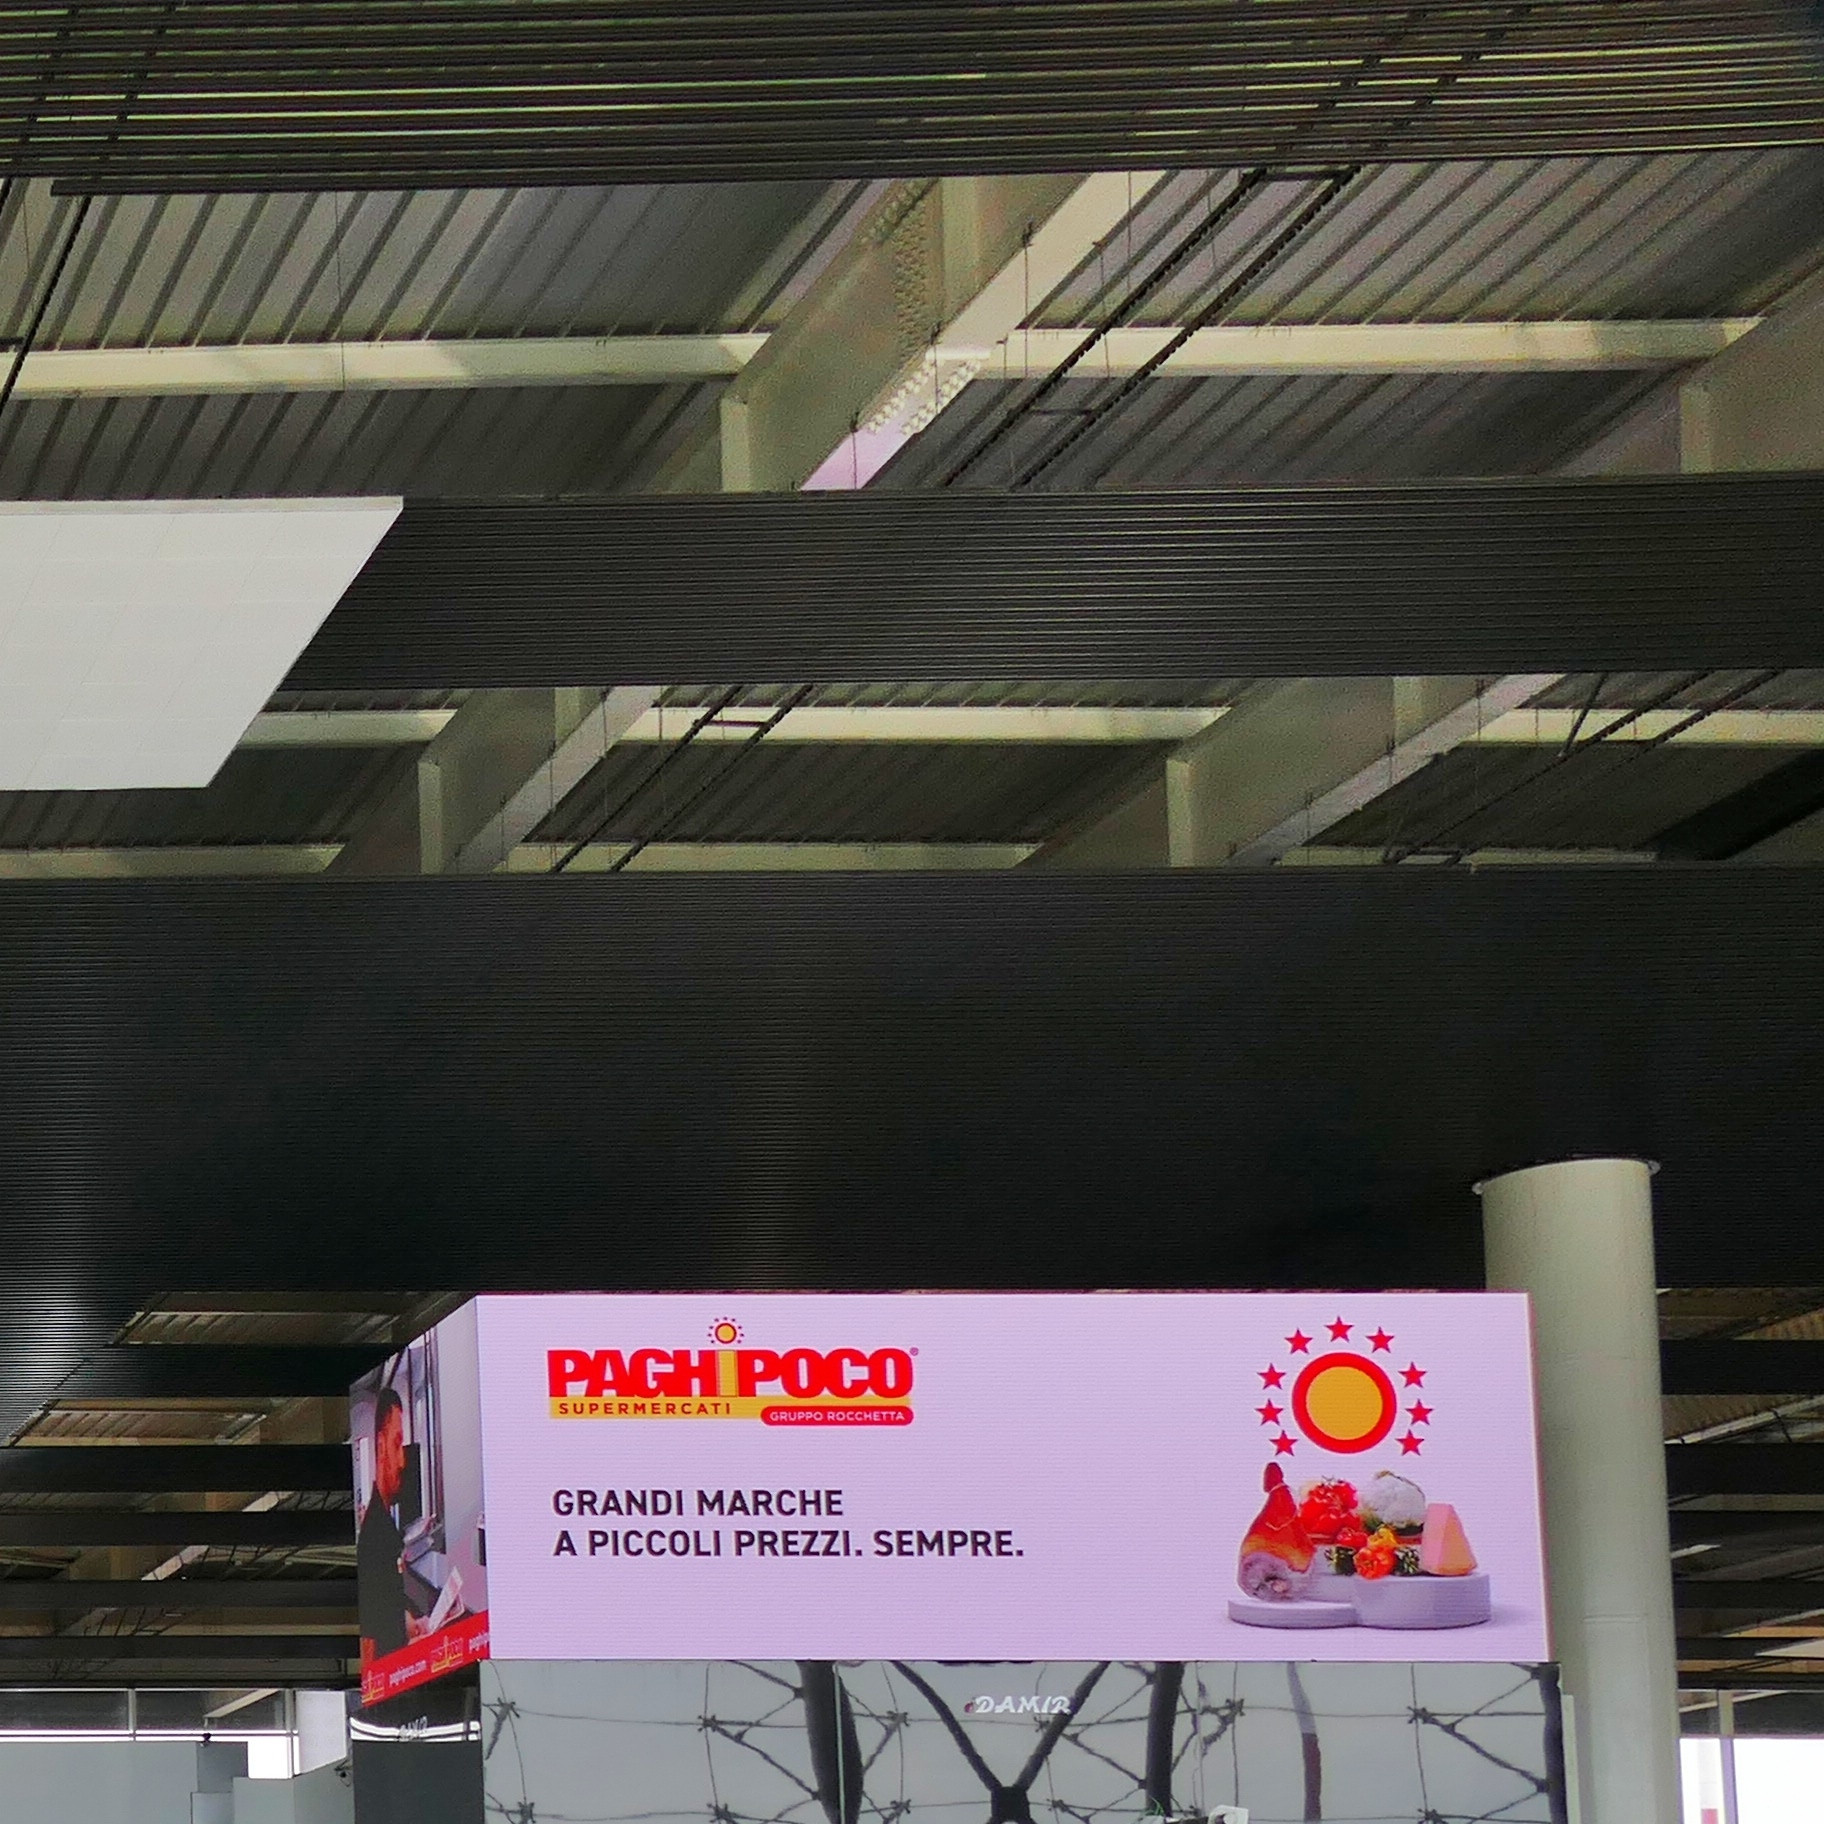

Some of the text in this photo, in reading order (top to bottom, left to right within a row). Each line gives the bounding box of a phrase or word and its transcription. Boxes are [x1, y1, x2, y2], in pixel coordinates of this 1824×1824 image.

[547, 1348, 914, 1399] PAGHIPOCO
[559, 1402, 732, 1416] SUPERMERCATI
[769, 1410, 906, 1422] GRUPPO ROCCHETTA
[552, 1489, 844, 1516] GRANDI MARCHE
[552, 1530, 1025, 1557] A PICCOLI PREZZI. SEMPRE.
[974, 1695, 1072, 1715] DAMIR
